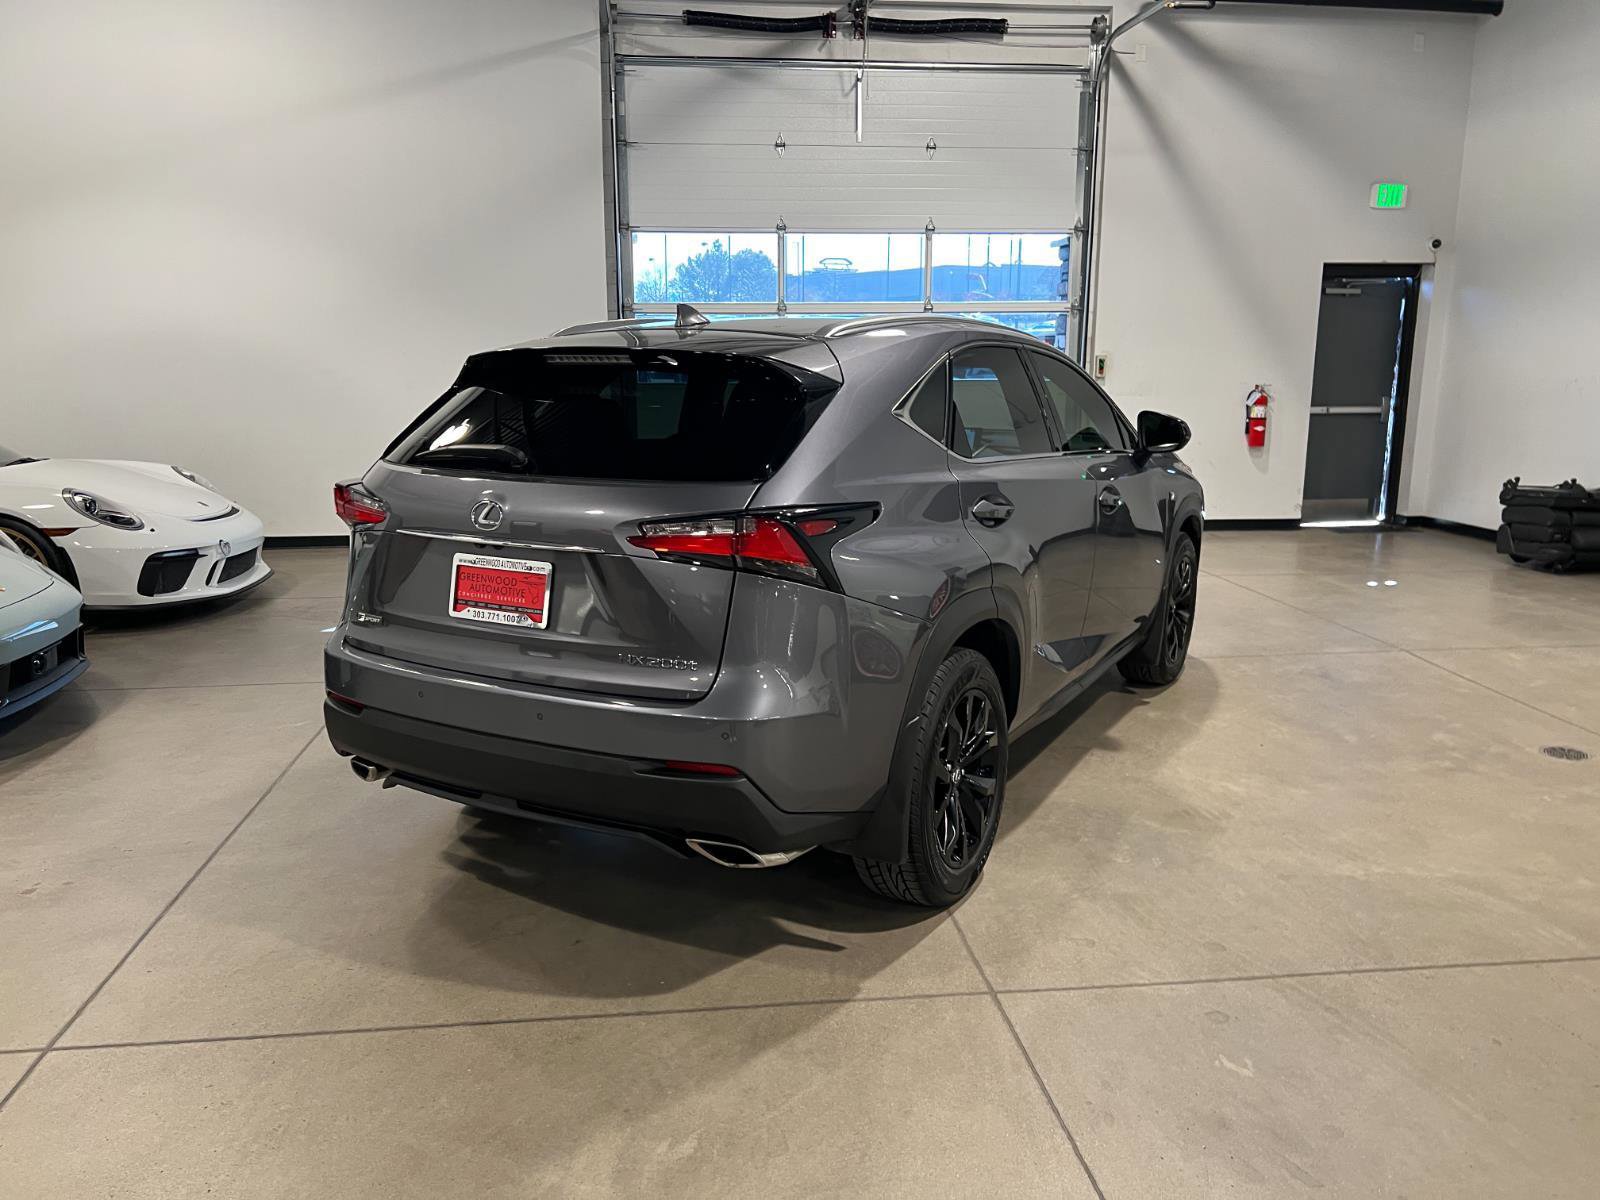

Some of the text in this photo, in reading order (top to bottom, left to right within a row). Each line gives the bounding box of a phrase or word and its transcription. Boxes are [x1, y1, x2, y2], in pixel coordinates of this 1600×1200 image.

[1376, 183, 1405, 208] EXIT
[460, 572, 517, 586] GREENWOOD
[469, 584, 526, 598] AUTOMOTIVE
